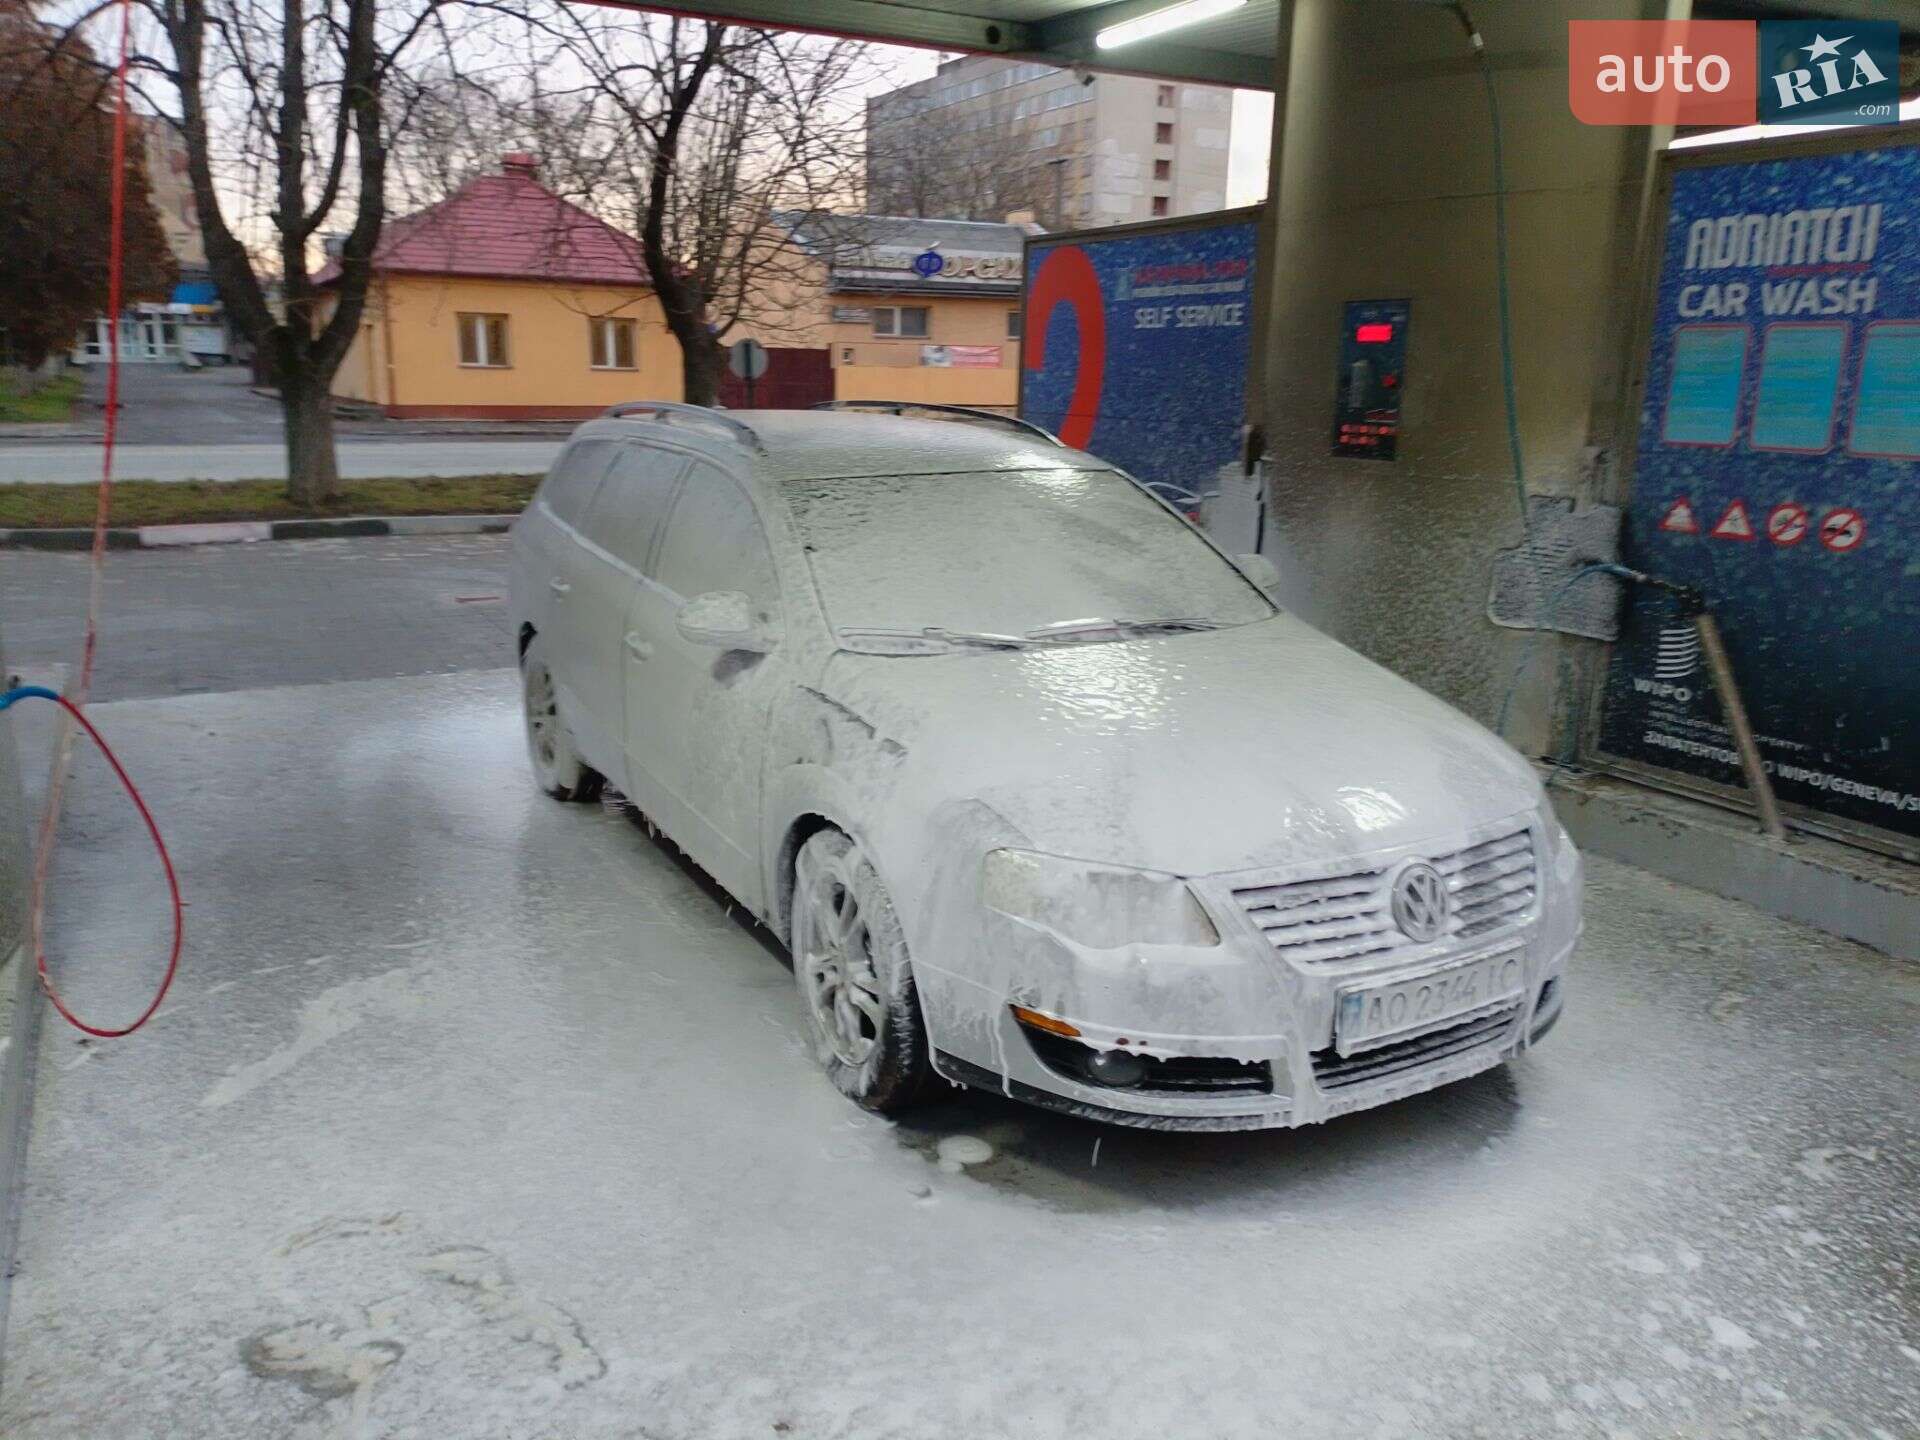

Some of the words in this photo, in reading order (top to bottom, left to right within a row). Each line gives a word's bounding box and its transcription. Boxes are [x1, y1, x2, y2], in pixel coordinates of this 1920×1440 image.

[1678, 282, 1750, 317] CAR
[1761, 276, 1880, 316] WASH
[1134, 306, 1173, 329] SELF
[1174, 303, 1246, 328] SERVICE
